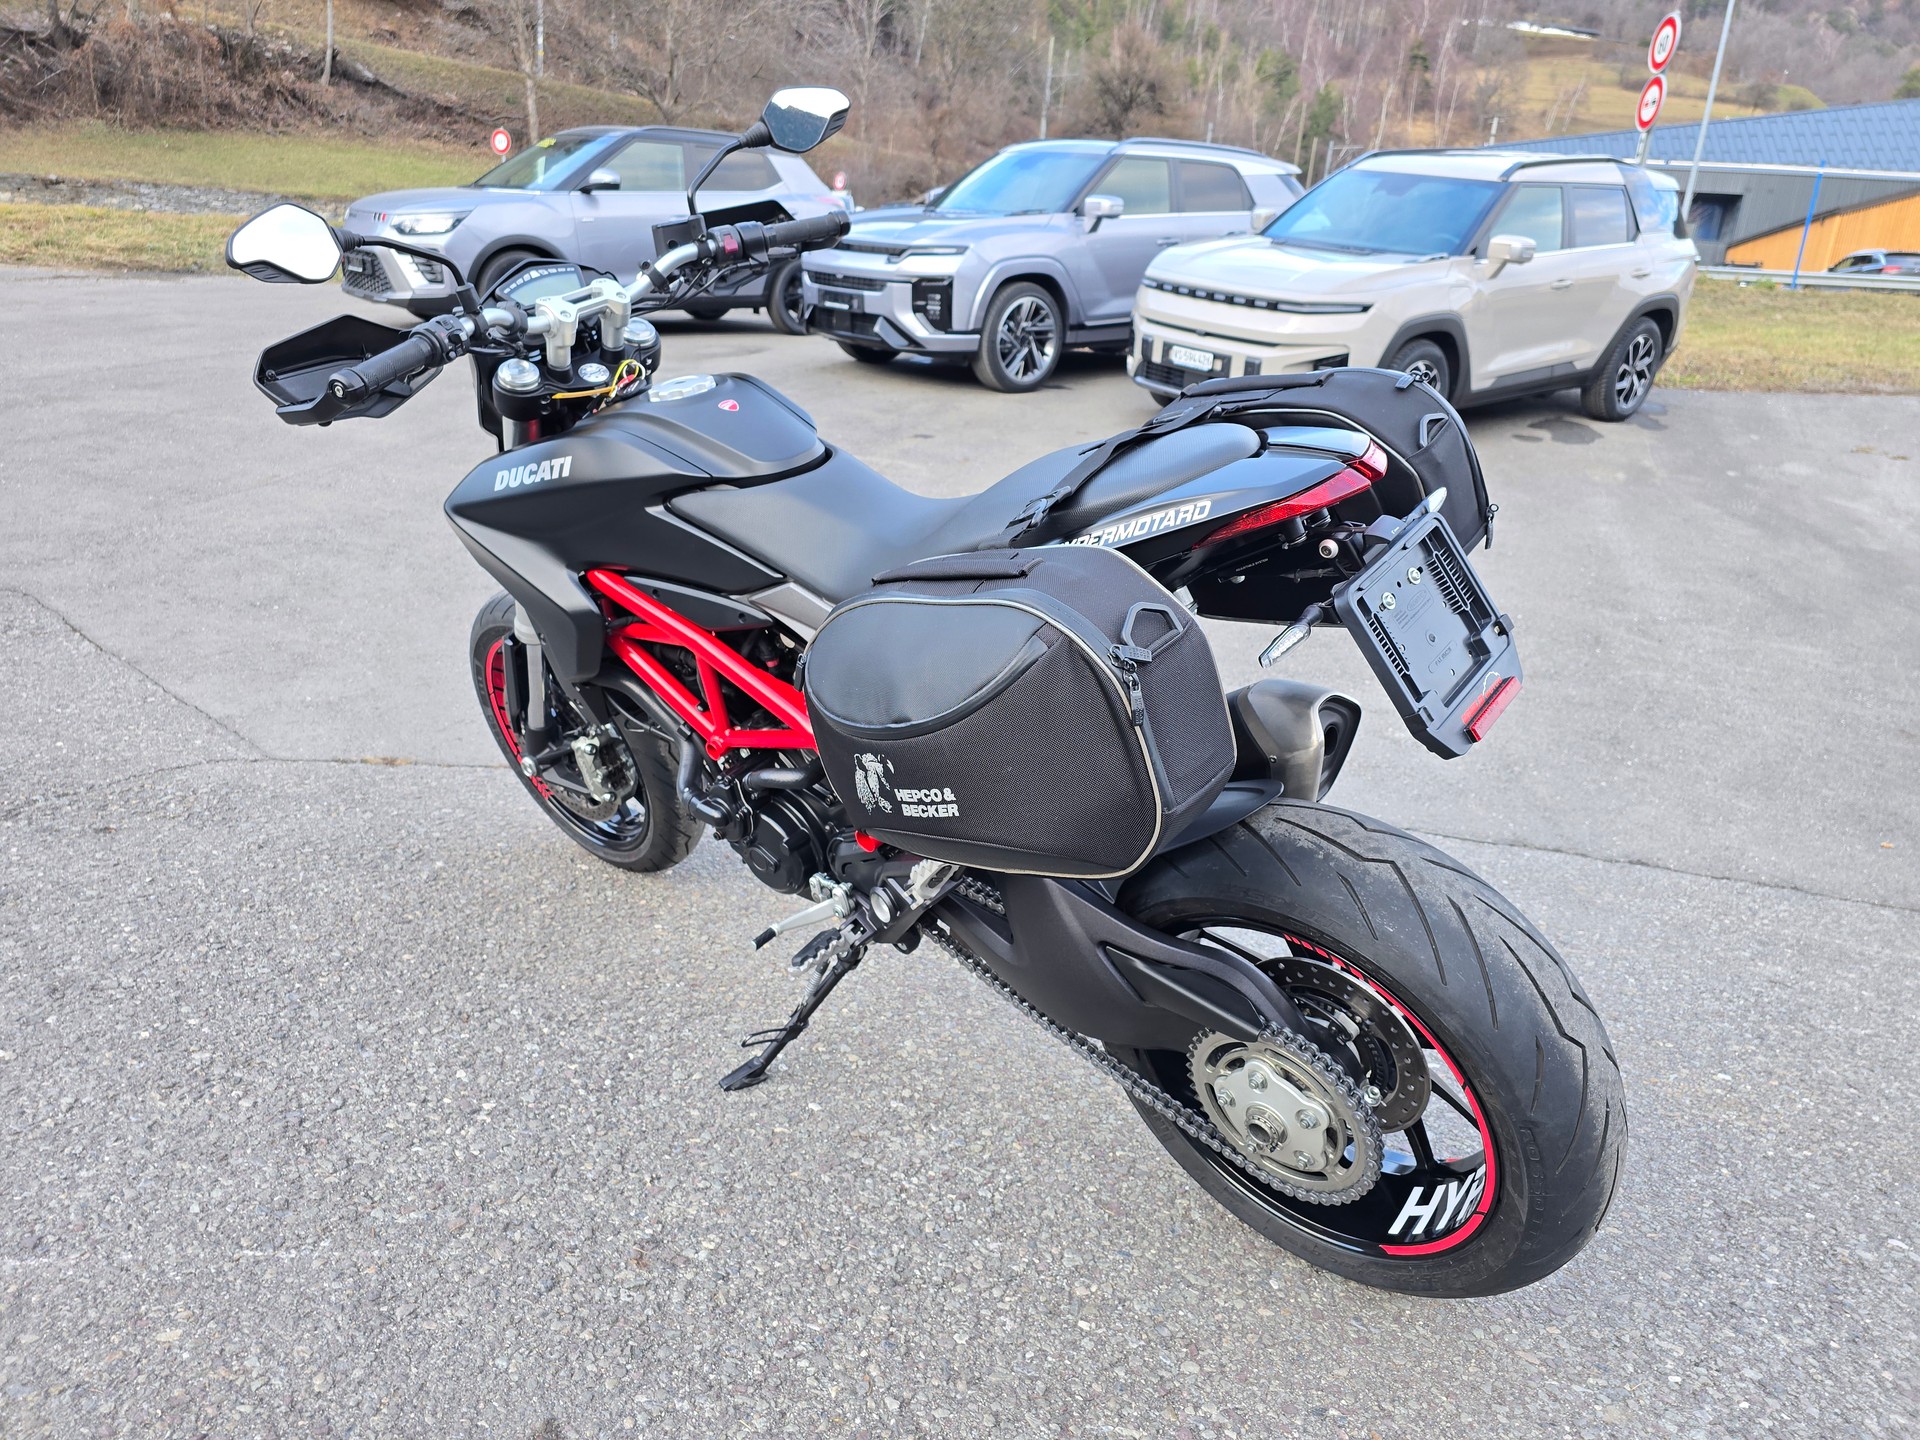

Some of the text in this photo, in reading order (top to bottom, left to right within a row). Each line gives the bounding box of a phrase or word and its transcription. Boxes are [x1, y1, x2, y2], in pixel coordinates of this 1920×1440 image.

[494, 456, 572, 492] DUCATI
[1061, 500, 1212, 546] PERMOTARD
[901, 803, 960, 818] BECKER
